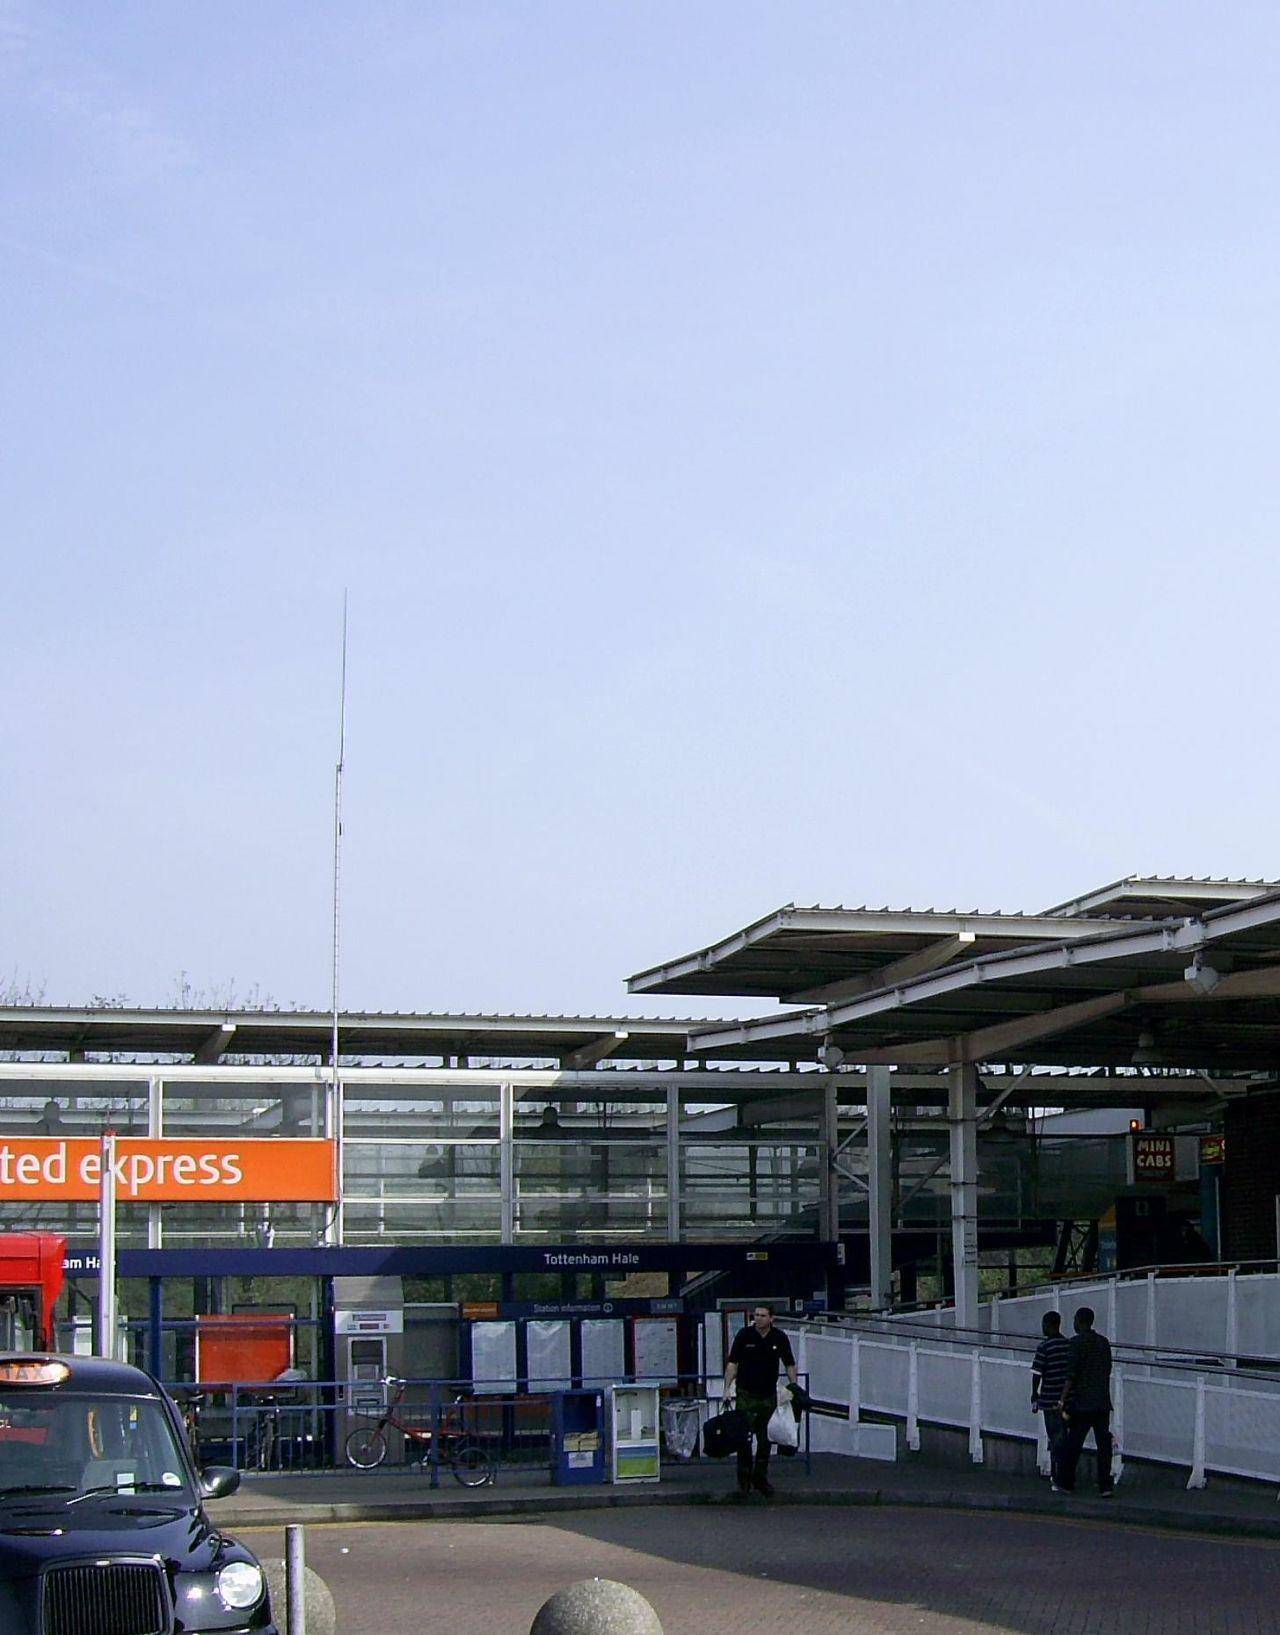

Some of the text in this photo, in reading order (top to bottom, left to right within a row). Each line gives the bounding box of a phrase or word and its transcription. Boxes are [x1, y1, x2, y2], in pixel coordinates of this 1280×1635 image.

[1137, 1139, 1171, 1152] MINI
[0, 1142, 67, 1184] ted
[1137, 1155, 1172, 1167] CABS
[543, 1253, 640, 1265] Tottenham Hale
[533, 1303, 559, 1313] Station
